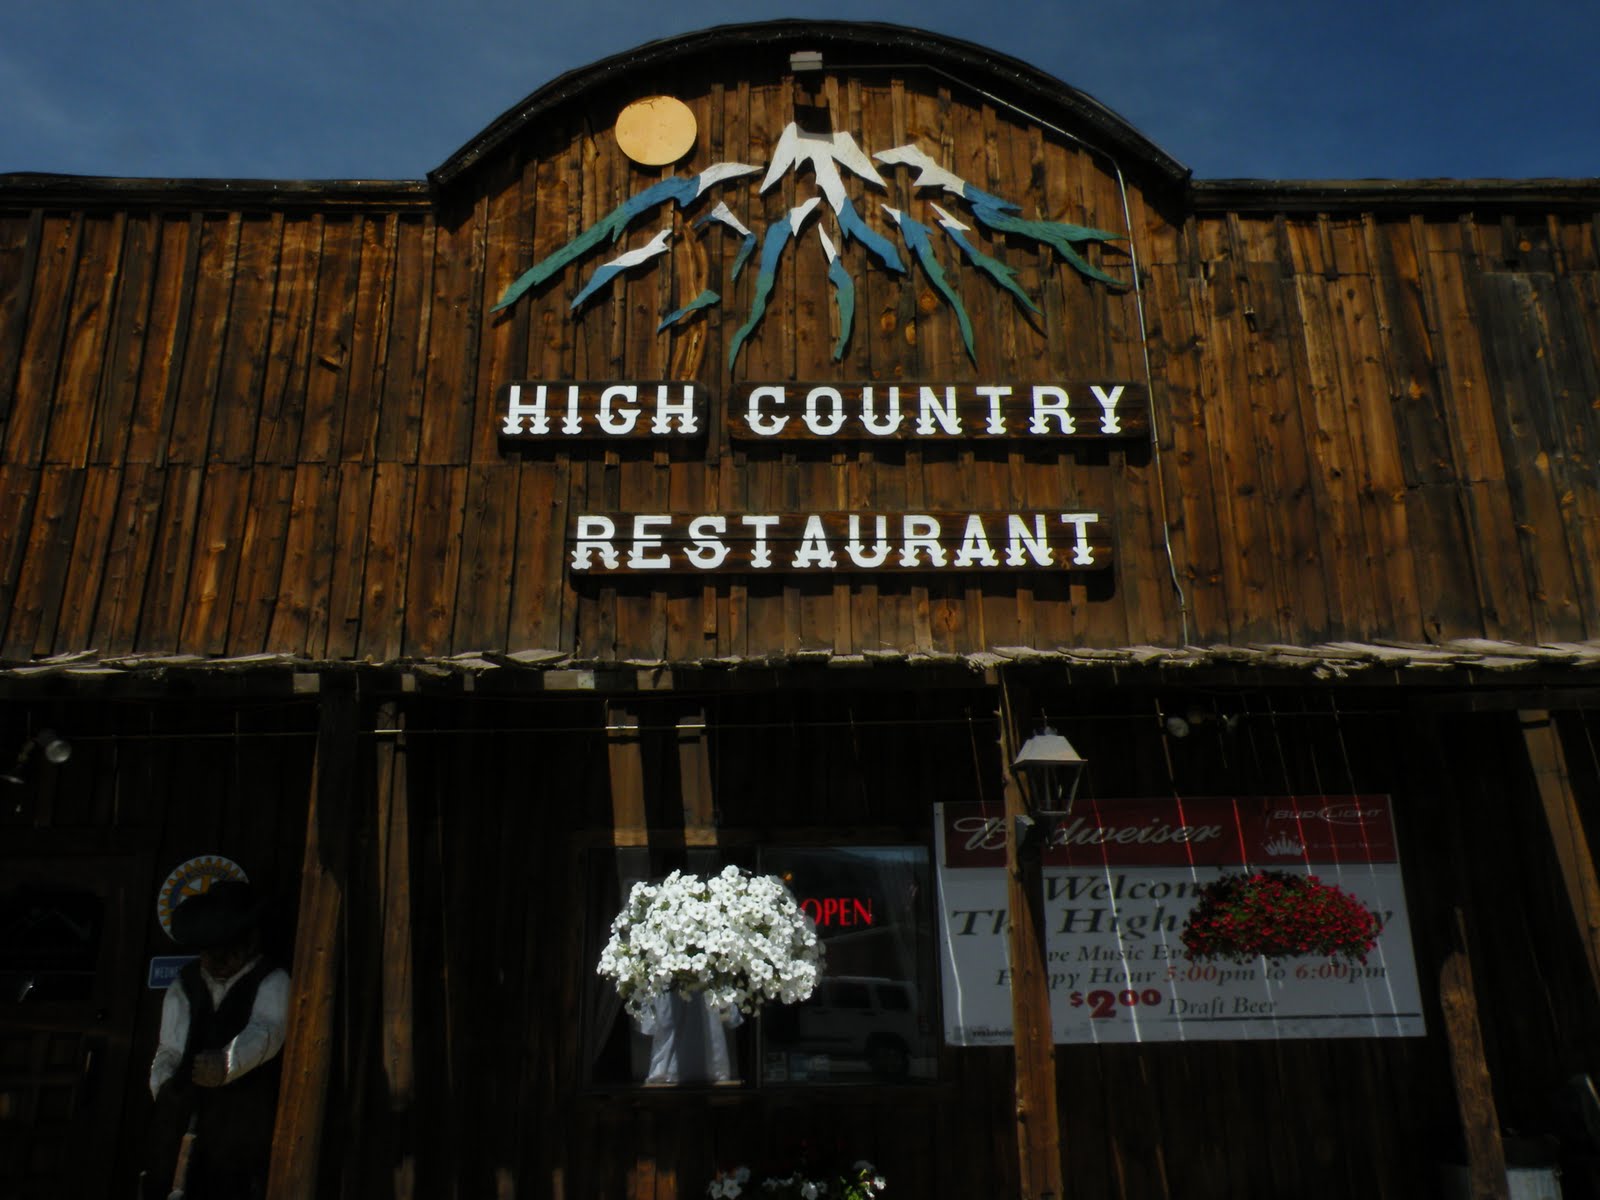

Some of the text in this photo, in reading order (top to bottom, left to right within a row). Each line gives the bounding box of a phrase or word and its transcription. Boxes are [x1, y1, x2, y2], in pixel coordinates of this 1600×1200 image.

[502, 385, 1126, 436] HIGH COUNTRY
[570, 512, 1100, 570] RESTAURANT
[953, 816, 1222, 851] Bdweiser
[1045, 874, 1202, 901] Welcom
[800, 897, 873, 927] OPEN
[952, 905, 1178, 941] Th High
[1077, 945, 1145, 962] Music
[1088, 966, 1156, 984] Hour
[1163, 964, 1255, 986] 5:00pm
[1265, 965, 1287, 981] to
[1295, 962, 1387, 983] 6:00pm
[1167, 997, 1225, 1017] Draft
[1232, 996, 1278, 1015] Beer
